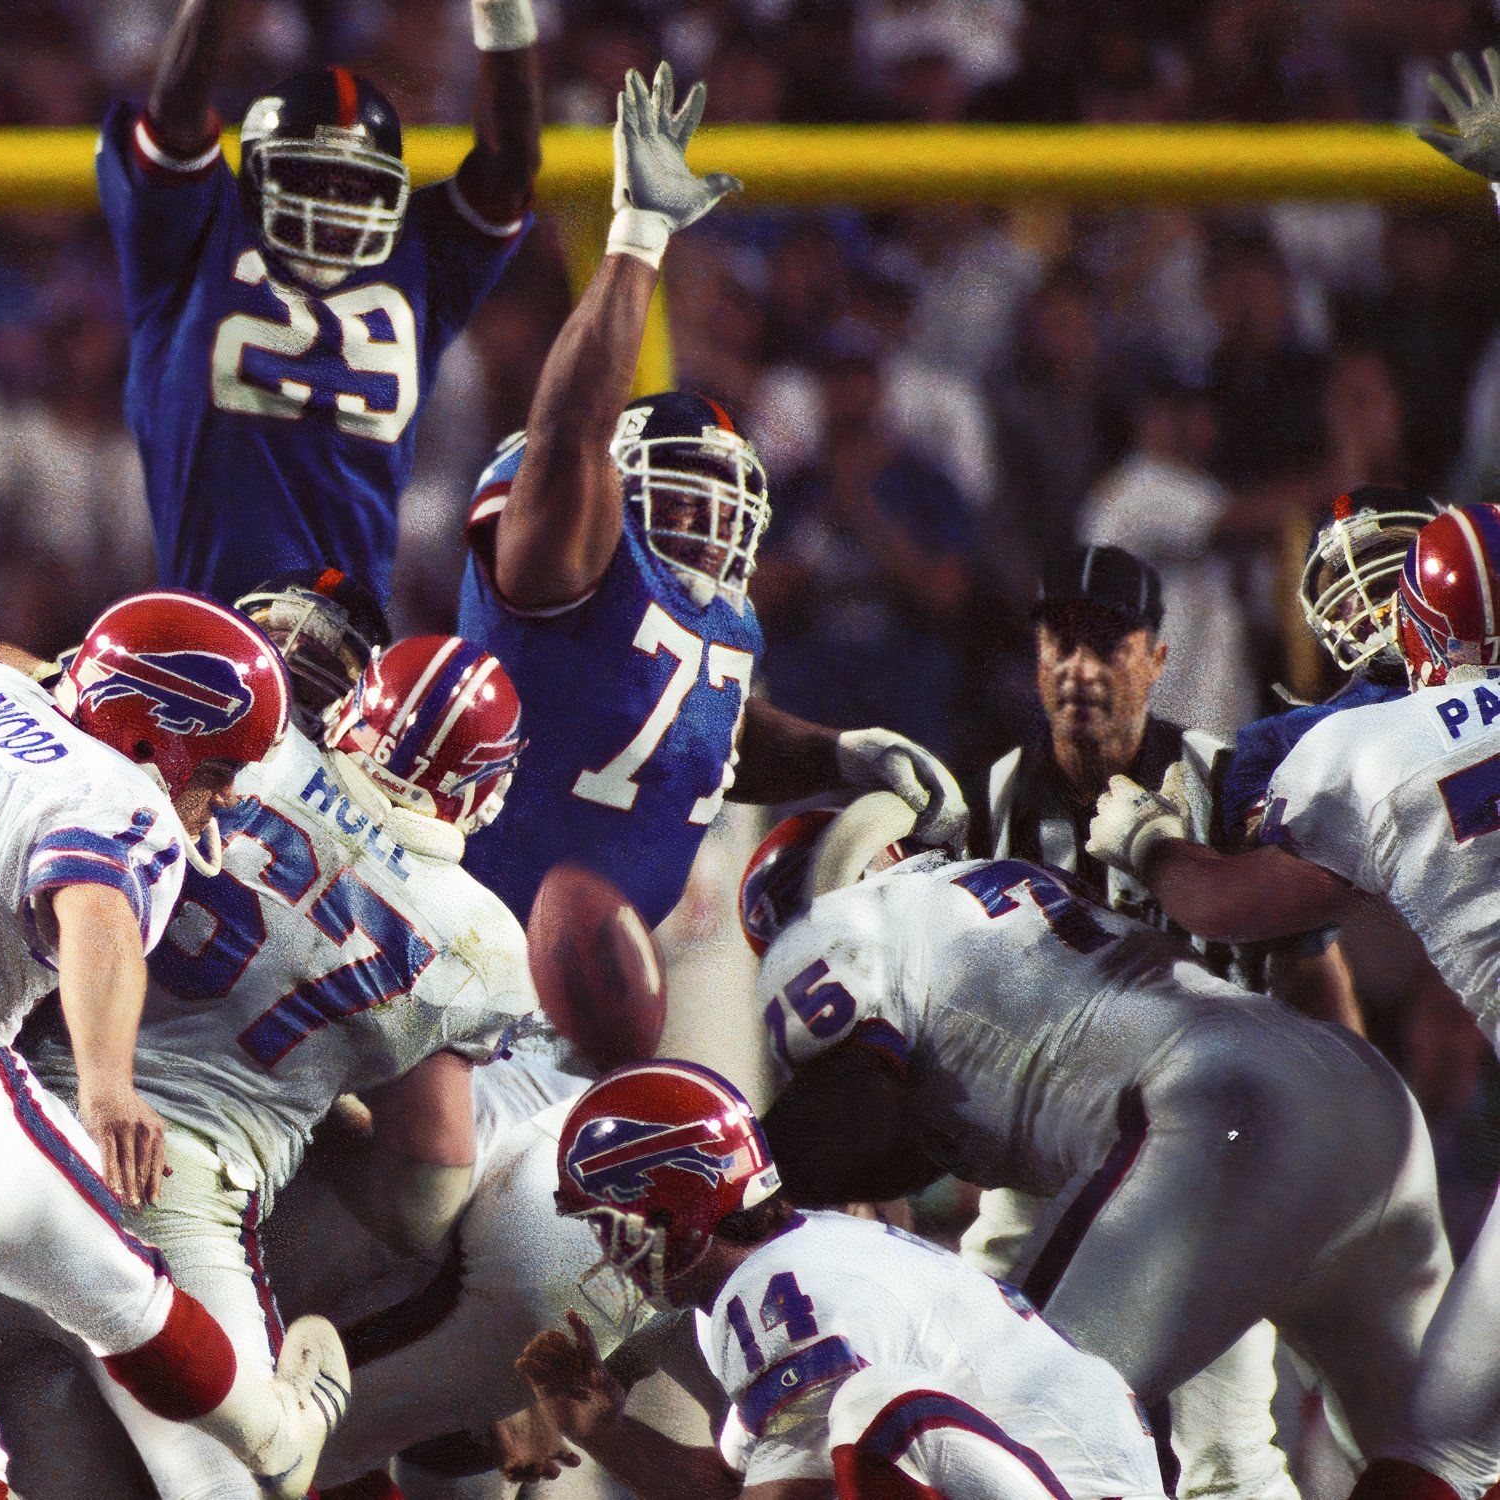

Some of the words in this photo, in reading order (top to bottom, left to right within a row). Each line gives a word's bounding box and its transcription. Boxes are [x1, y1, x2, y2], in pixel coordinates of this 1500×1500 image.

[211, 249, 418, 444] 29
[373, 735, 397, 765] 6
[407, 755, 431, 784] 7
[571, 600, 754, 825] 77
[146, 795, 437, 1067] 67
[727, 1272, 818, 1374] 14
